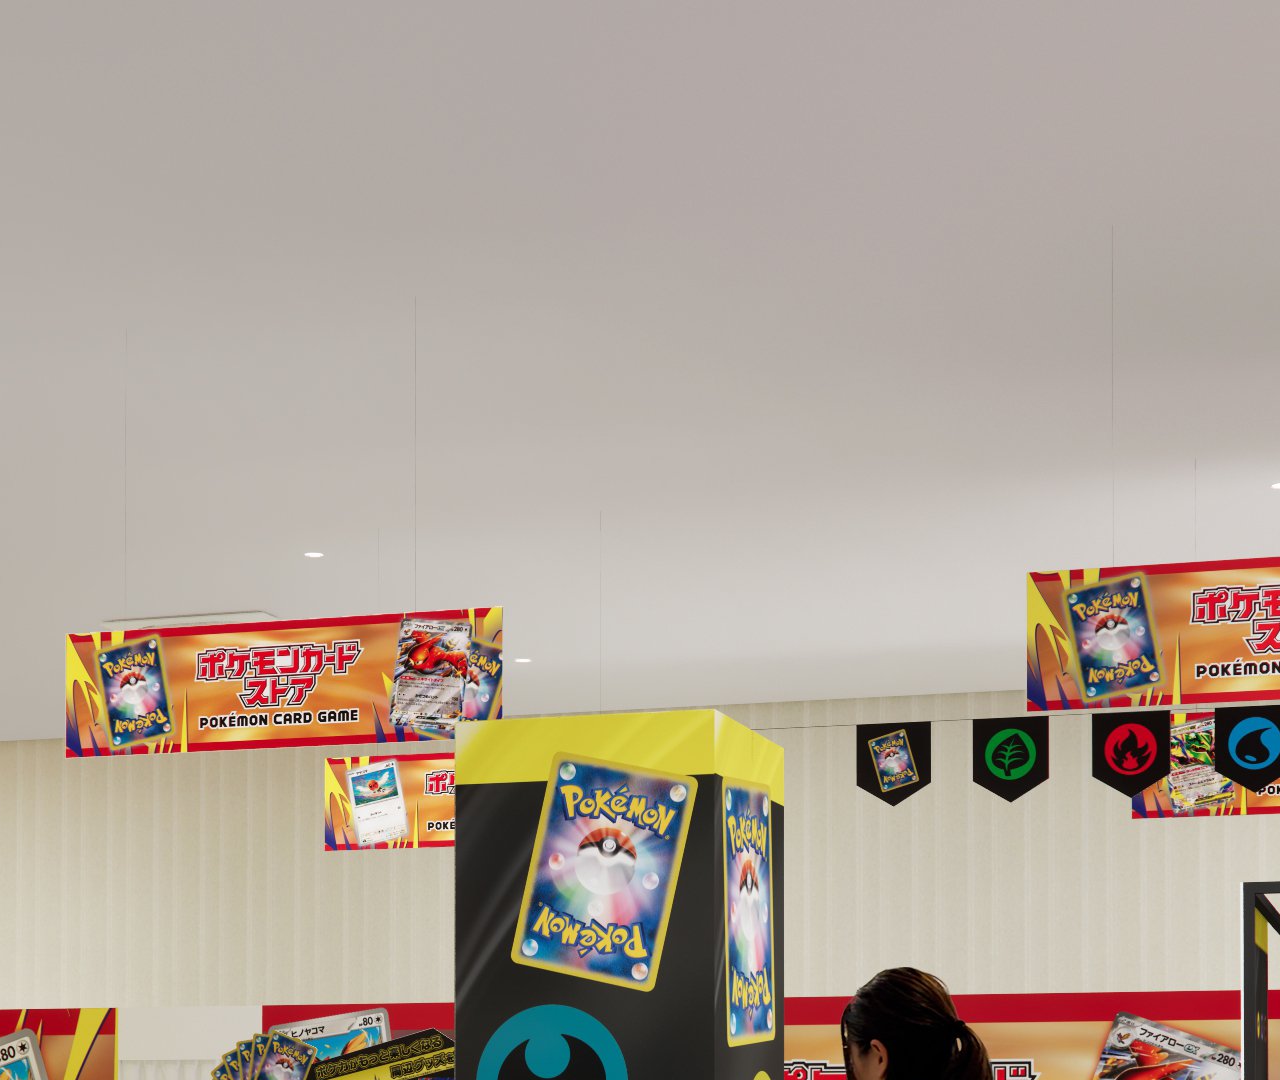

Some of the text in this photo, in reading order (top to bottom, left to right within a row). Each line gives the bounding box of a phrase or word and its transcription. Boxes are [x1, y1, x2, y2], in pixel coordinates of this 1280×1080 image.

[195, 640, 363, 681] ポケモンカード
[239, 675, 317, 708] ストア
[199, 709, 359, 728] POKÉMON CARD GAME
[428, 819, 455, 831] POKÉ
[291, 1017, 373, 1037] ヒノヤコマ 80
[0, 1046, 16, 1062] 80
[315, 1035, 443, 1080] ポケカがもっと楽しくなる
[1217, 1053, 1235, 1067] 280
